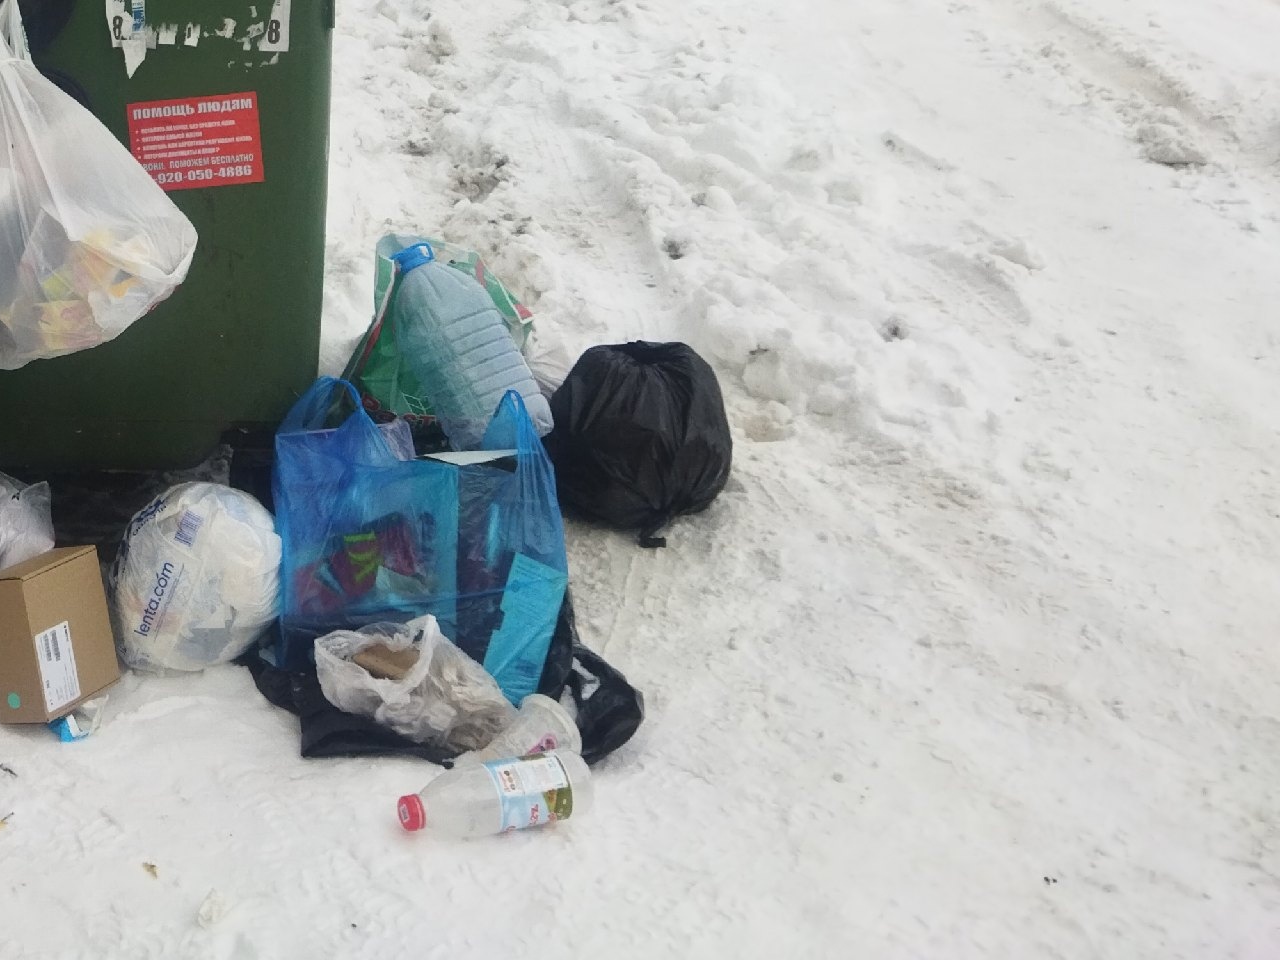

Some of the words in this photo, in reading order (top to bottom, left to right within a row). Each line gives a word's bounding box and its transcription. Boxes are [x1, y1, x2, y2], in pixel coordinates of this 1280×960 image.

[132, 103, 195, 120] ПОМОЩЬ
[197, 98, 253, 115] ЛЮДЯМ
[169, 157, 210, 169] ПОМОЖЕМ
[211, 153, 254, 165] БЕСПЛАТНО
[133, 561, 175, 638] lenta.com
